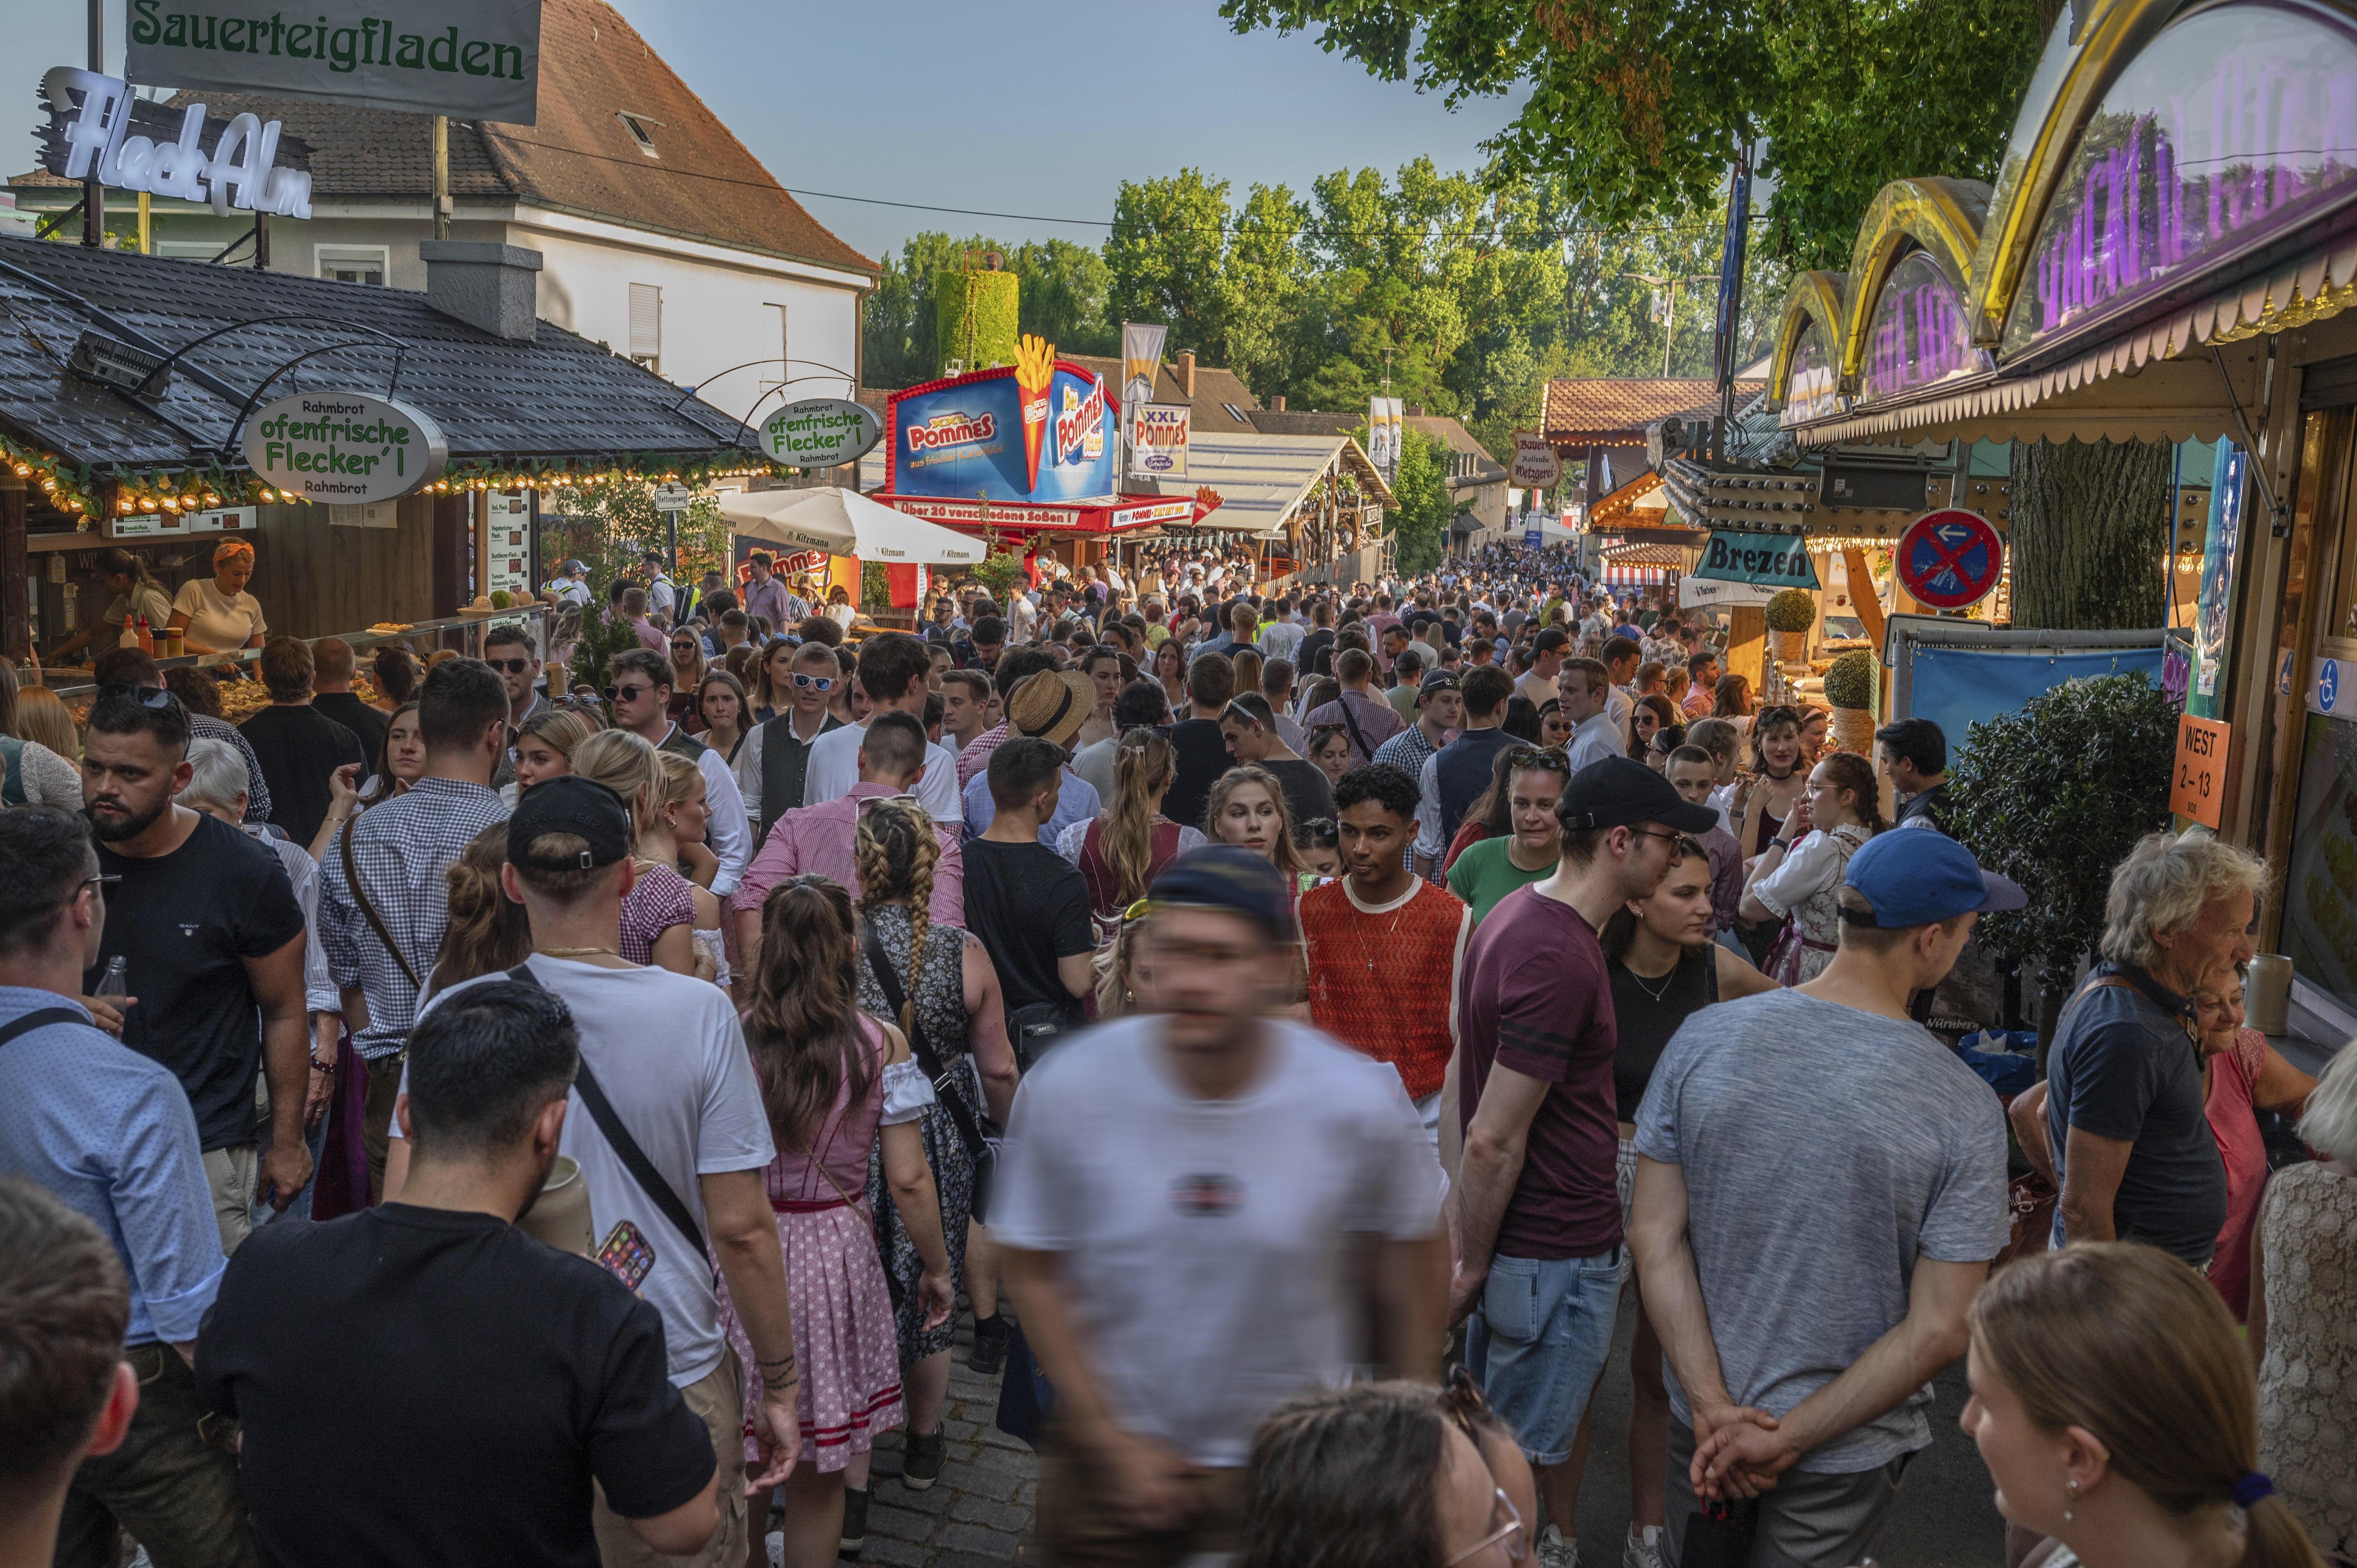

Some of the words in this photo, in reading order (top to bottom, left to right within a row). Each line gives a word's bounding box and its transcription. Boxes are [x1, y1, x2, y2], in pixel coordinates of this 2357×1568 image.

[131, 0, 525, 80] Sauerteigfladen
[302, 400, 365, 415] Rahmbrot
[1065, 390, 1077, 411] Der
[793, 404, 833, 414] Rahmbrot
[1146, 411, 1179, 422] XXL
[260, 413, 410, 444] ofenfrische
[769, 410, 863, 434] ofenfrische
[931, 415, 968, 428] XXL
[1085, 433, 1102, 452] Stand
[800, 452, 839, 463] Rahmbrot
[305, 480, 368, 494] Rahmbrot
[659, 495, 686, 504] Rettungsweg
[901, 502, 929, 516] Über
[931, 506, 946, 516] 20
[1027, 510, 1064, 522] Soßen
[1153, 507, 1165, 517] KULT
[1165, 506, 1175, 516] SEIT
[1175, 505, 1185, 514] 1999
[796, 532, 829, 548] Kitzmann
[881, 547, 905, 557] Kitzmann
[947, 549, 970, 558] Kitzmann
[1708, 537, 1807, 577] Brezen
[1699, 586, 1717, 595] Tucher
[2185, 725, 2217, 758] WEST
[2180, 764, 2187, 789] 2
[2199, 770, 2210, 798] 13
[2187, 802, 2196, 814] SOS
[1926, 1018, 1979, 1033] Nürnberg
